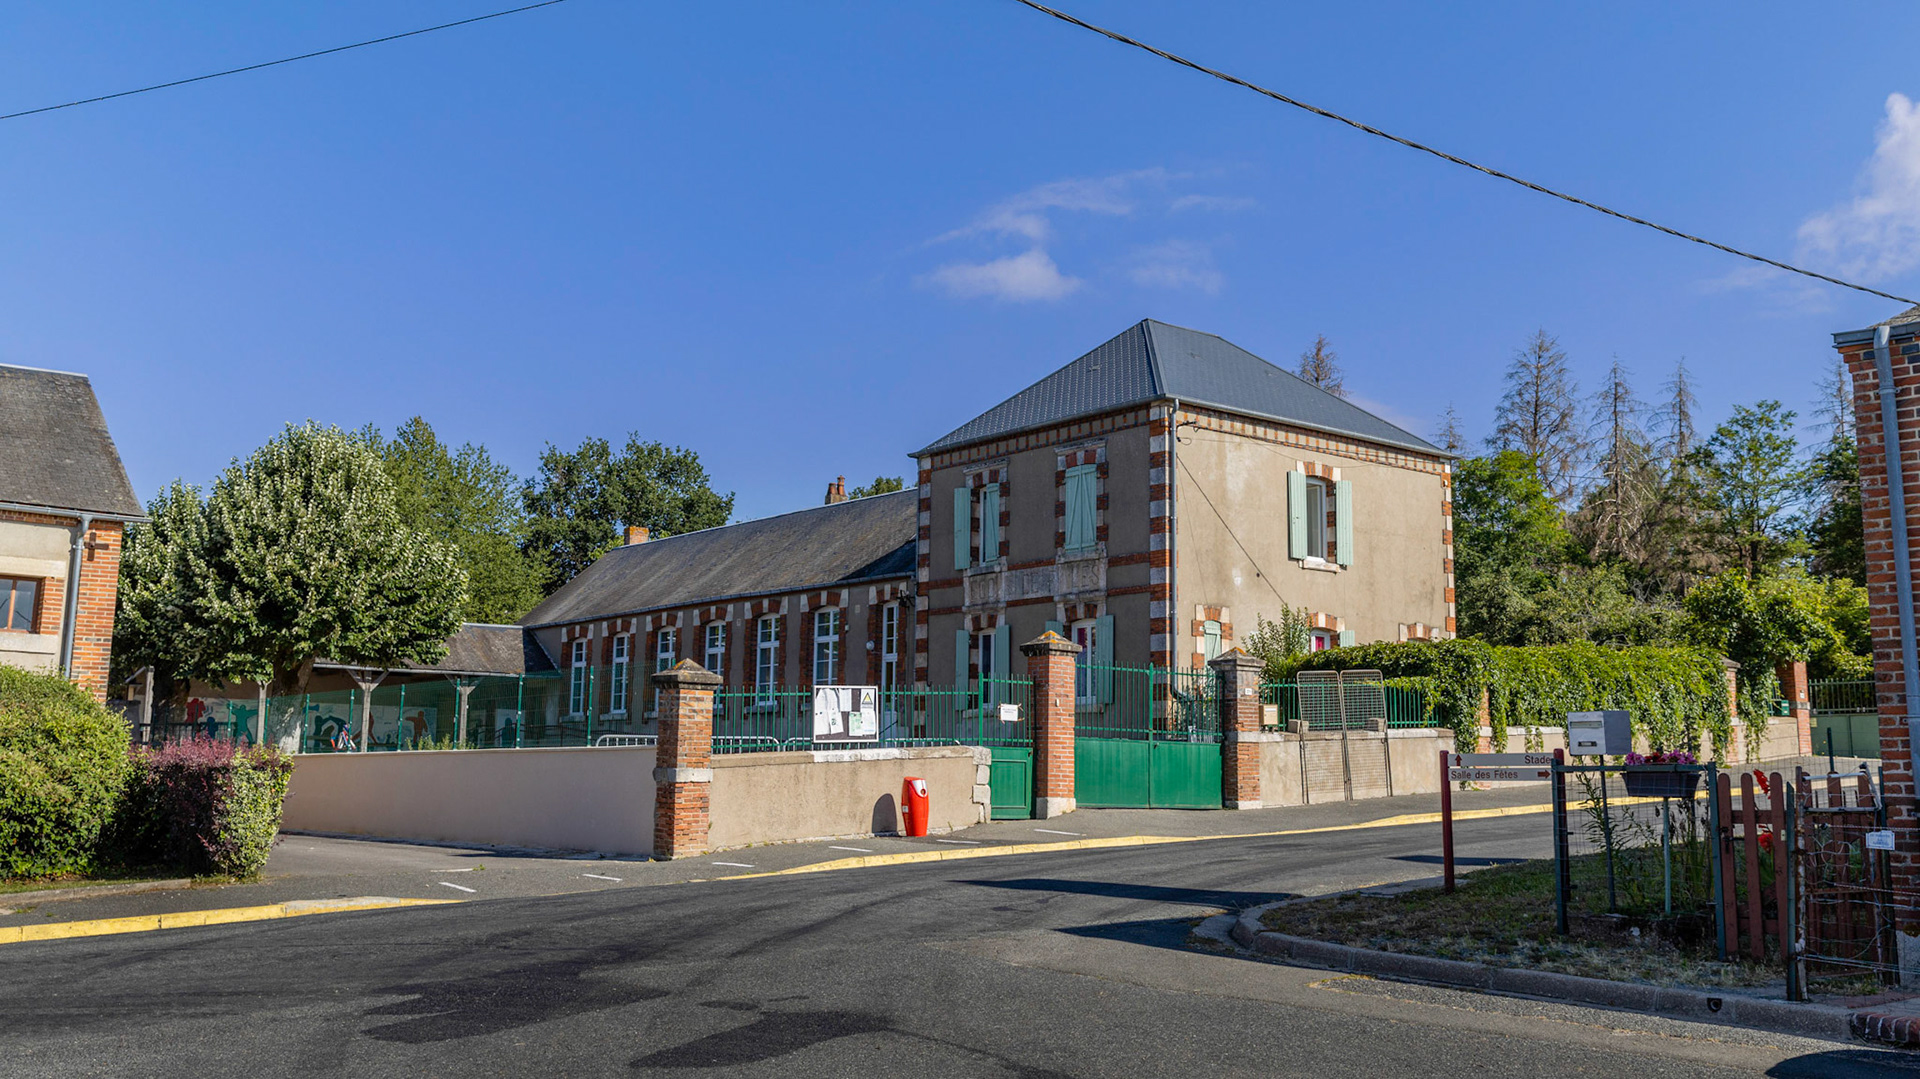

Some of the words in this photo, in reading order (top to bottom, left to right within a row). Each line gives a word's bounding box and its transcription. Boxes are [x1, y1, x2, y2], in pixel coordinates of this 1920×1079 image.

[1524, 754, 1551, 764] Stade
[1450, 770, 1472, 780] Salle
[1475, 770, 1491, 779] des
[1494, 769, 1519, 779] Fêtes
